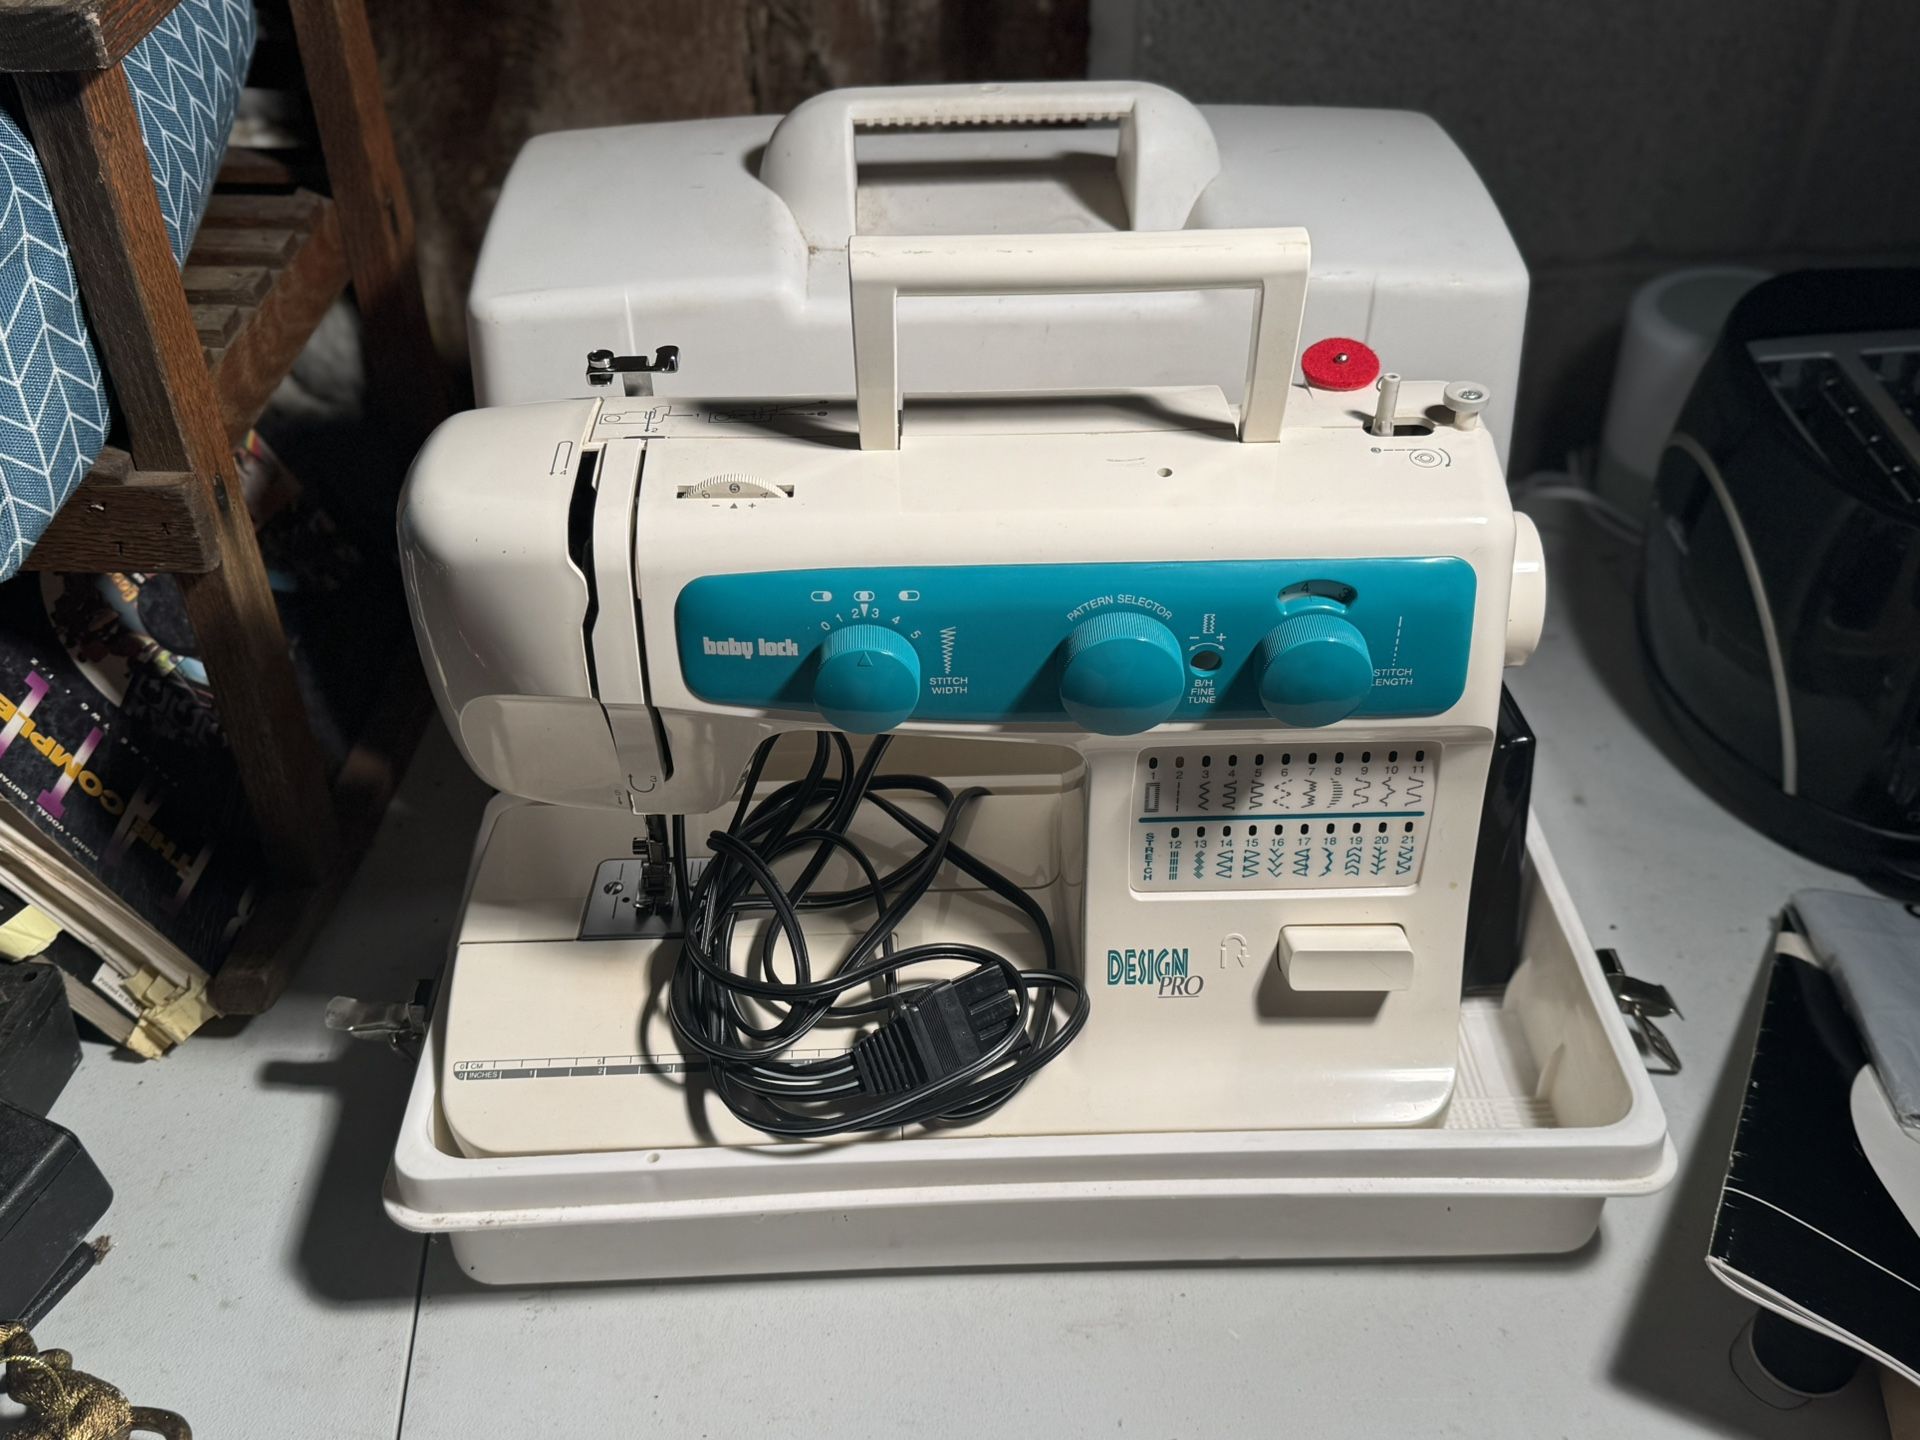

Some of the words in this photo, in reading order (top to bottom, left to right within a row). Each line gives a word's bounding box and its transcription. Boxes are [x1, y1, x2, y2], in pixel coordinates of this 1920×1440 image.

[1066, 594, 1114, 622] PATTERN
[1117, 593, 1173, 620] SELECTOR
[851, 608, 861, 618] 2
[871, 608, 880, 618] 3
[835, 614, 844, 623] 1
[891, 615, 902, 625] 4
[820, 621, 831, 631] 0
[910, 629, 922, 640] 5
[703, 637, 753, 660] baby
[758, 638, 799, 657] lock
[1373, 668, 1413, 677] STITCH
[929, 677, 969, 686] STITCH
[1193, 679, 1214, 688] B/H
[1371, 677, 1414, 686] ENGTH
[931, 686, 968, 695] WIDTH
[1190, 688, 1216, 696] FINE
[1188, 696, 1217, 704] TUNE
[1176, 771, 1183, 780] 2
[1202, 770, 1210, 779] 3
[1228, 770, 1236, 778] 4
[1254, 769, 1262, 778] 5
[1281, 768, 1288, 777] 6
[1308, 768, 1316, 776] 7
[1334, 767, 1342, 776] 8
[1360, 766, 1369, 775] 9
[1385, 766, 1399, 775] 10
[1412, 766, 1424, 774] 11
[0, 771, 29, 802] GUITA
[36, 805, 65, 833] VOCAL
[1169, 840, 1182, 849] 12
[1195, 840, 1207, 849] 13
[1221, 839, 1232, 848] 14
[1246, 839, 1258, 848] 15
[1272, 838, 1284, 847] 16
[1298, 837, 1311, 846] 17
[1324, 836, 1337, 846] 18
[1350, 836, 1363, 845] 19
[1374, 836, 1389, 845] 20
[1401, 835, 1414, 844] 21
[71, 836, 99, 862] PIANO
[1107, 948, 1188, 985] DESIGN
[1158, 975, 1204, 996] PRO
[470, 1062, 484, 1070] CM
[468, 1070, 498, 1079] INCHES
